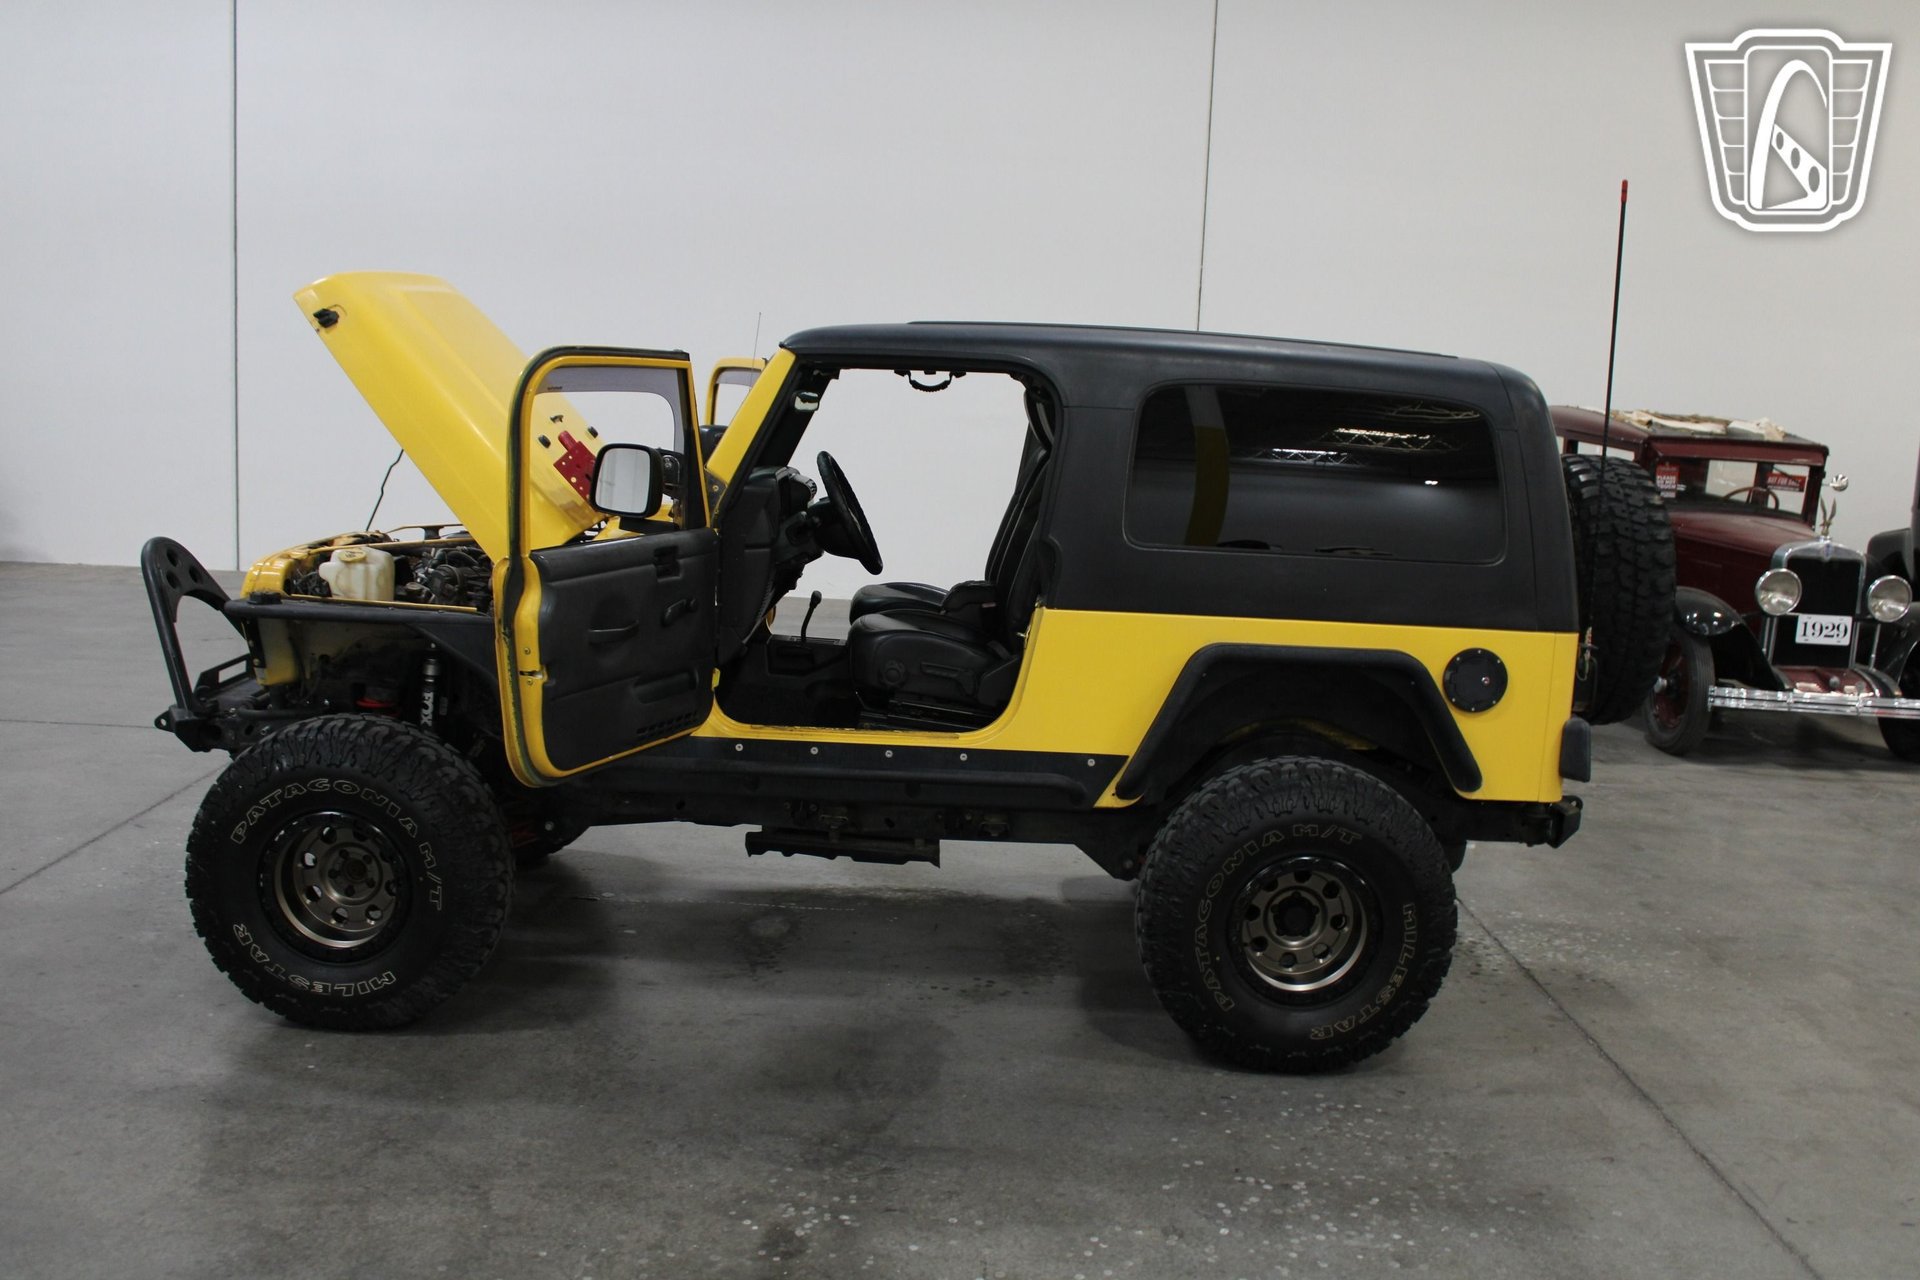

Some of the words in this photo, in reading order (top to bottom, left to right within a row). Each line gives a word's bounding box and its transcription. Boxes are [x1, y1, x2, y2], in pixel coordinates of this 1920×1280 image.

[1801, 621, 1848, 639] 1929
[421, 691, 434, 727] FOX
[230, 778, 418, 844] PATAGONIA
[418, 841, 442, 911] M/T
[232, 922, 397, 997] MILESTAR
[1195, 830, 1285, 1012] PATAGONIA
[1292, 823, 1363, 845] M/T
[1310, 903, 1417, 1040] MILESTAR
